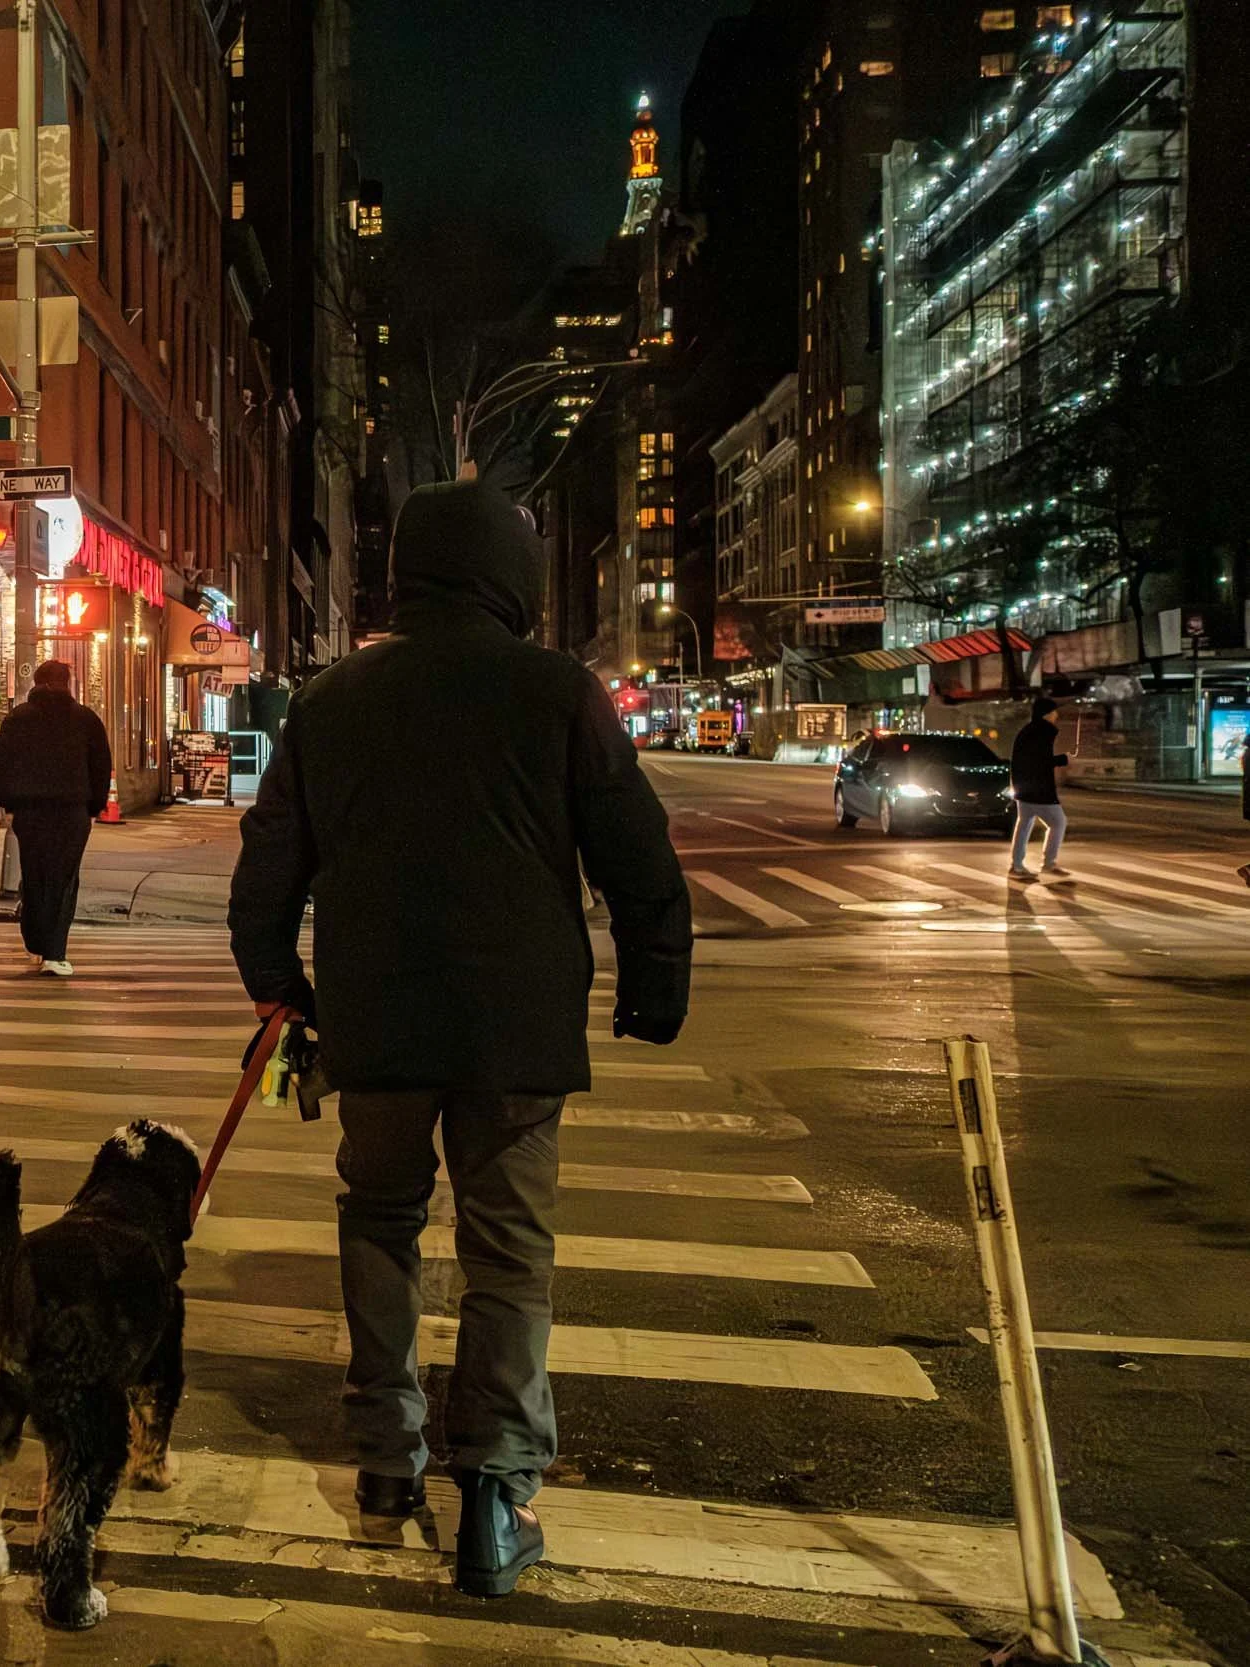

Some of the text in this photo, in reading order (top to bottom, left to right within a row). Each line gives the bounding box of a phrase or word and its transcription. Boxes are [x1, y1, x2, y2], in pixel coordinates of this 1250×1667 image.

[34, 477, 61, 490] WAY
[99, 526, 131, 595] DINER
[141, 556, 165, 608] GRILL
[203, 675, 235, 697] ATM
